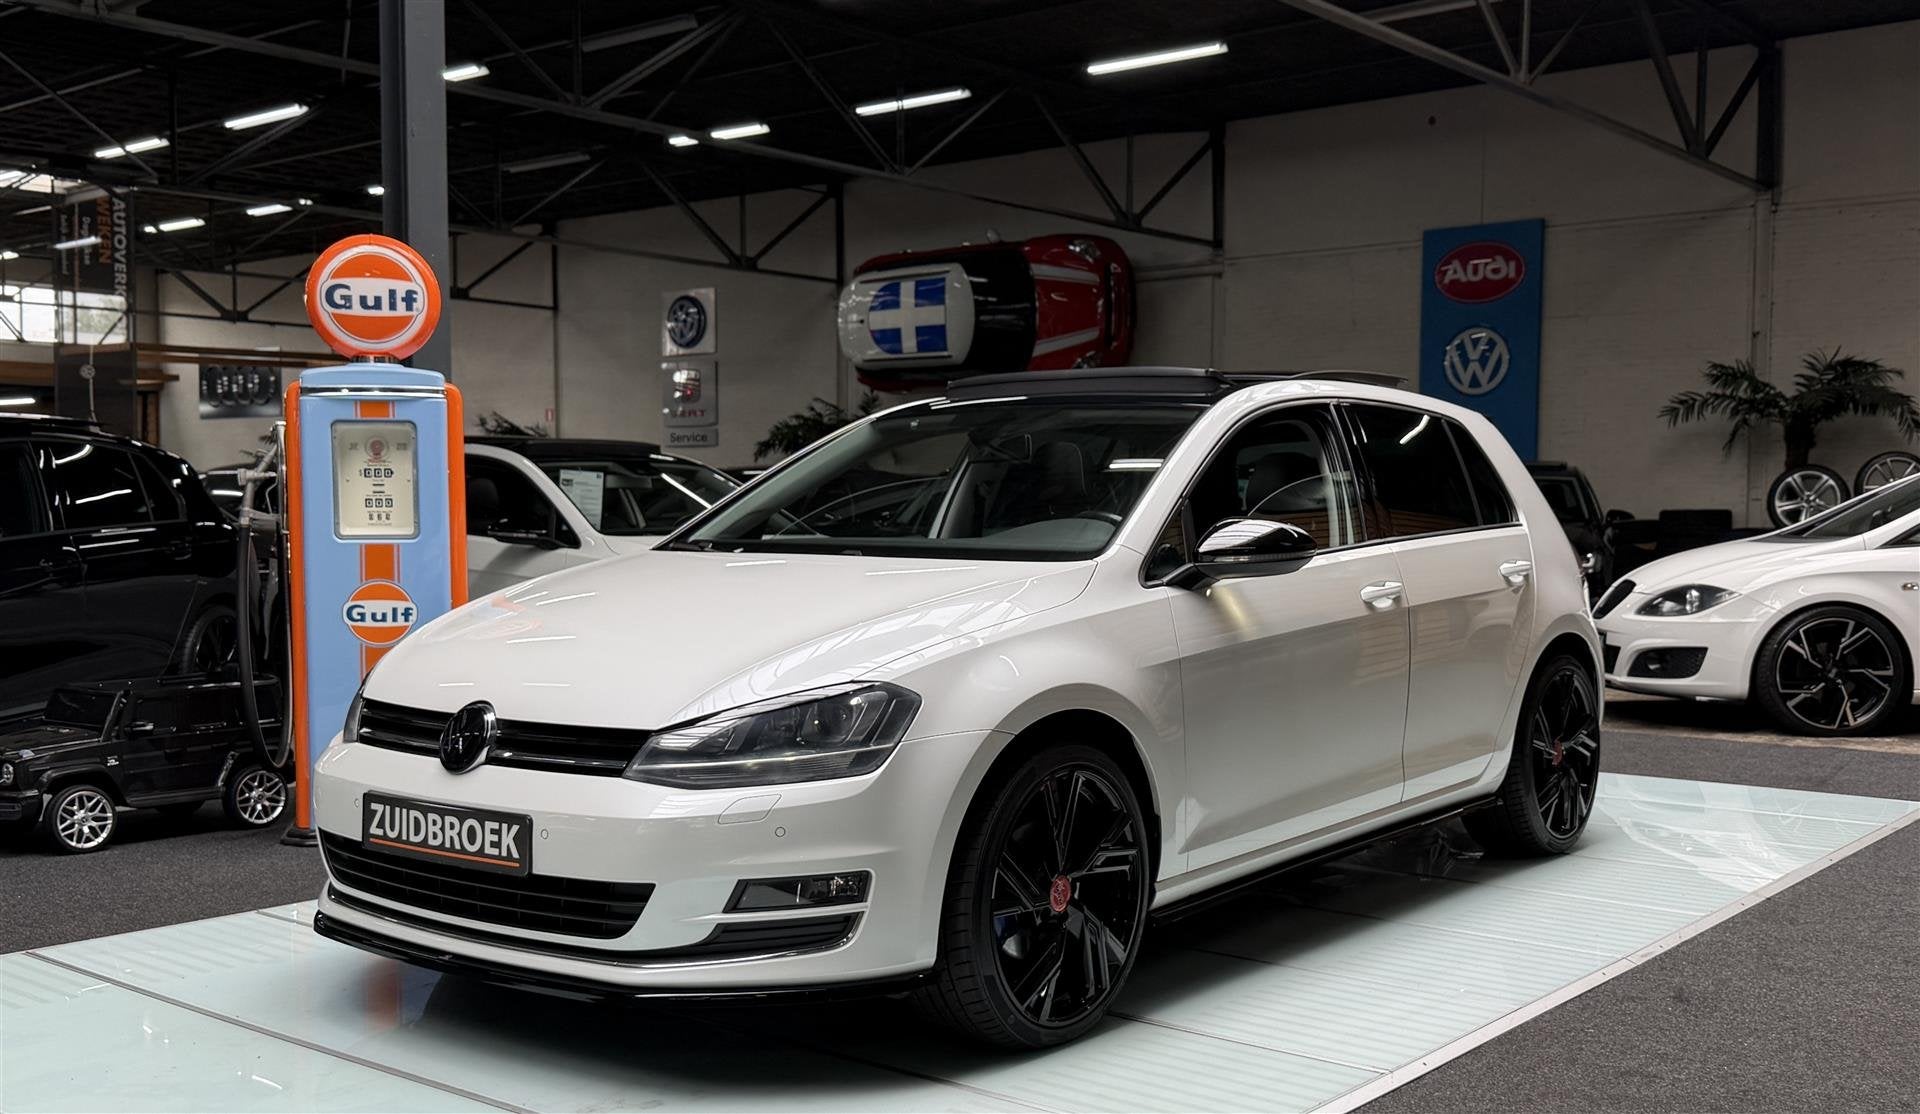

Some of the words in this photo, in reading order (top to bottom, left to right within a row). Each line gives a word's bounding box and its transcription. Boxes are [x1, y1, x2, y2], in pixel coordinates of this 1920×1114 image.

[324, 283, 419, 312] Gulf
[670, 432, 708, 443] Service
[345, 604, 413, 624] Gulf
[369, 802, 520, 859] ZUIDBROEK
